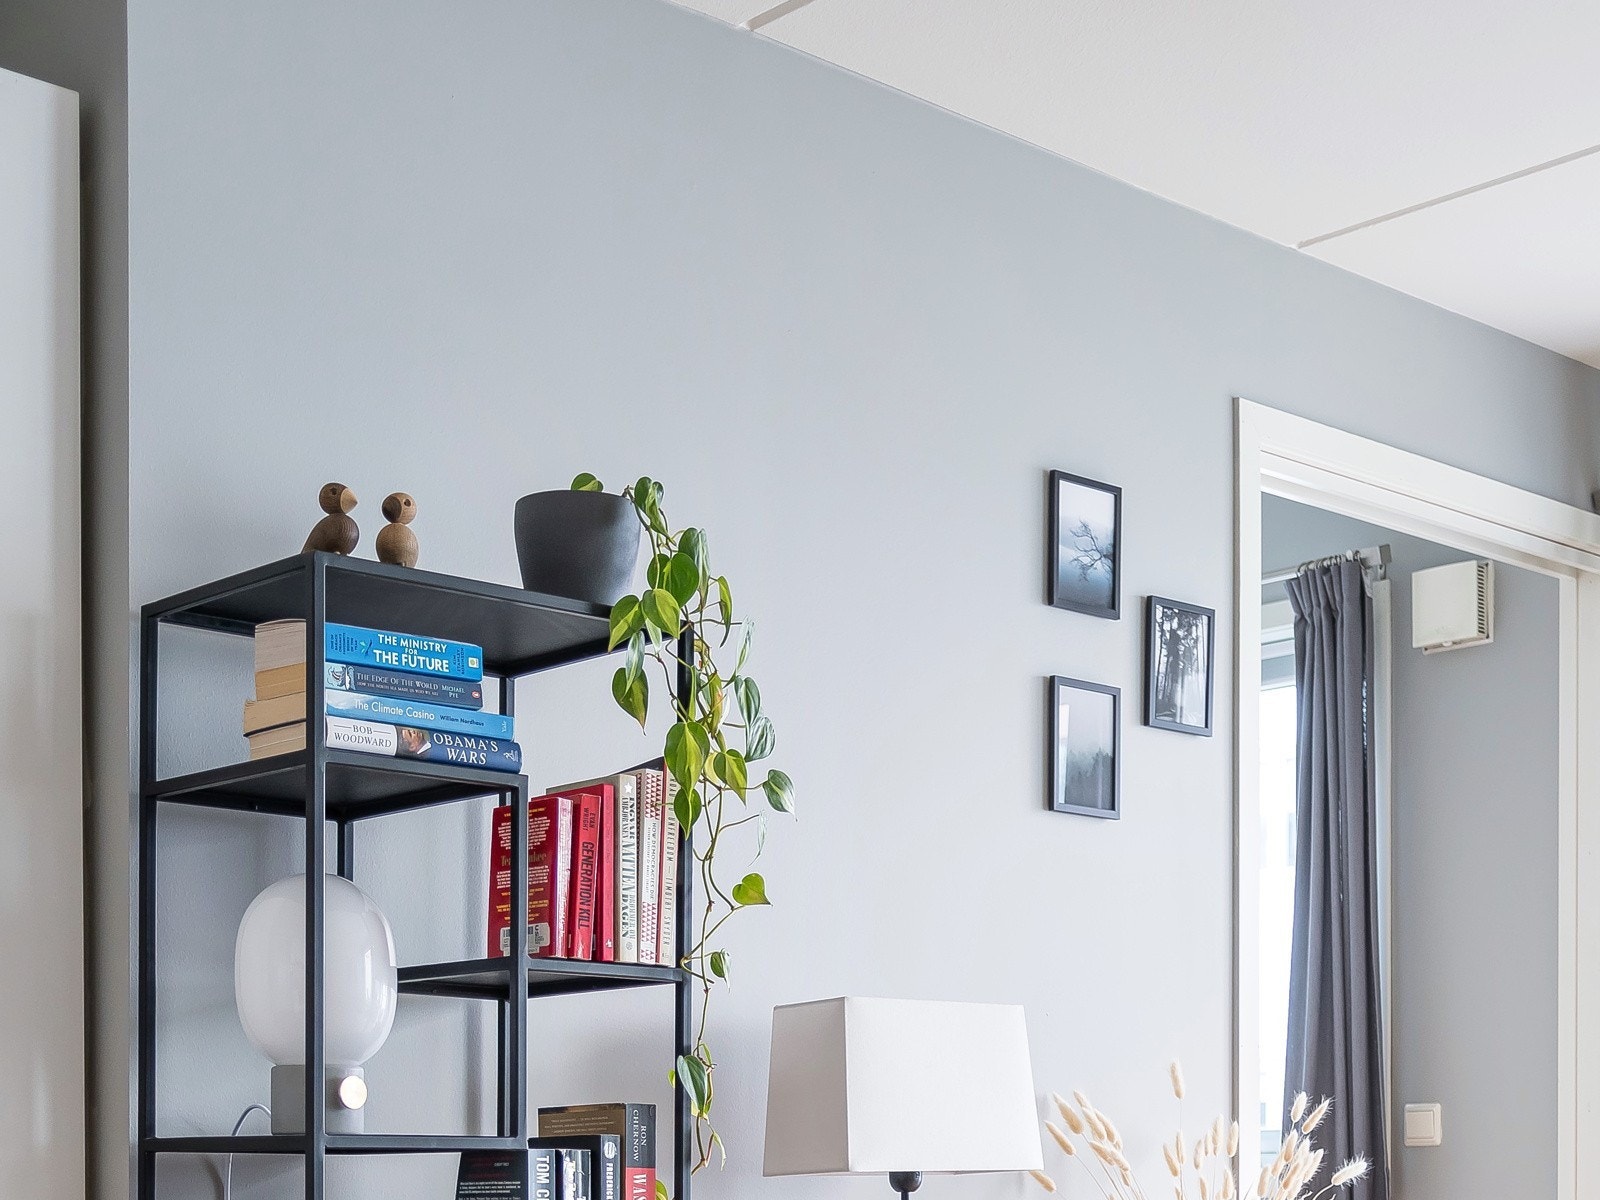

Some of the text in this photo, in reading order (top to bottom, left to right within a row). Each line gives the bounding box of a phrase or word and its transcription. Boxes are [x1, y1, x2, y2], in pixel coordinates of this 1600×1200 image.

[378, 634, 447, 653] THE MINISTRY
[373, 650, 450, 673] THE FUTURE
[372, 675, 388, 683] EDGE
[400, 679, 414, 687] THE
[415, 681, 438, 691] WORLD
[442, 685, 465, 694] MICHAEL
[354, 700, 435, 720] The Climate Casino
[353, 725, 373, 734] BOB
[460, 718, 484, 726] Nordhaus
[334, 733, 392, 748] WOODWARD
[433, 733, 499, 752] OBAMA'S
[447, 748, 487, 765] WARS
[667, 816, 675, 861] UNFREEDOM
[622, 840, 635, 891] NATTEN
[578, 842, 595, 929] GENERATION KILL
[665, 878, 673, 911] TIMOTHY
[536, 1156, 550, 1184] TOM
